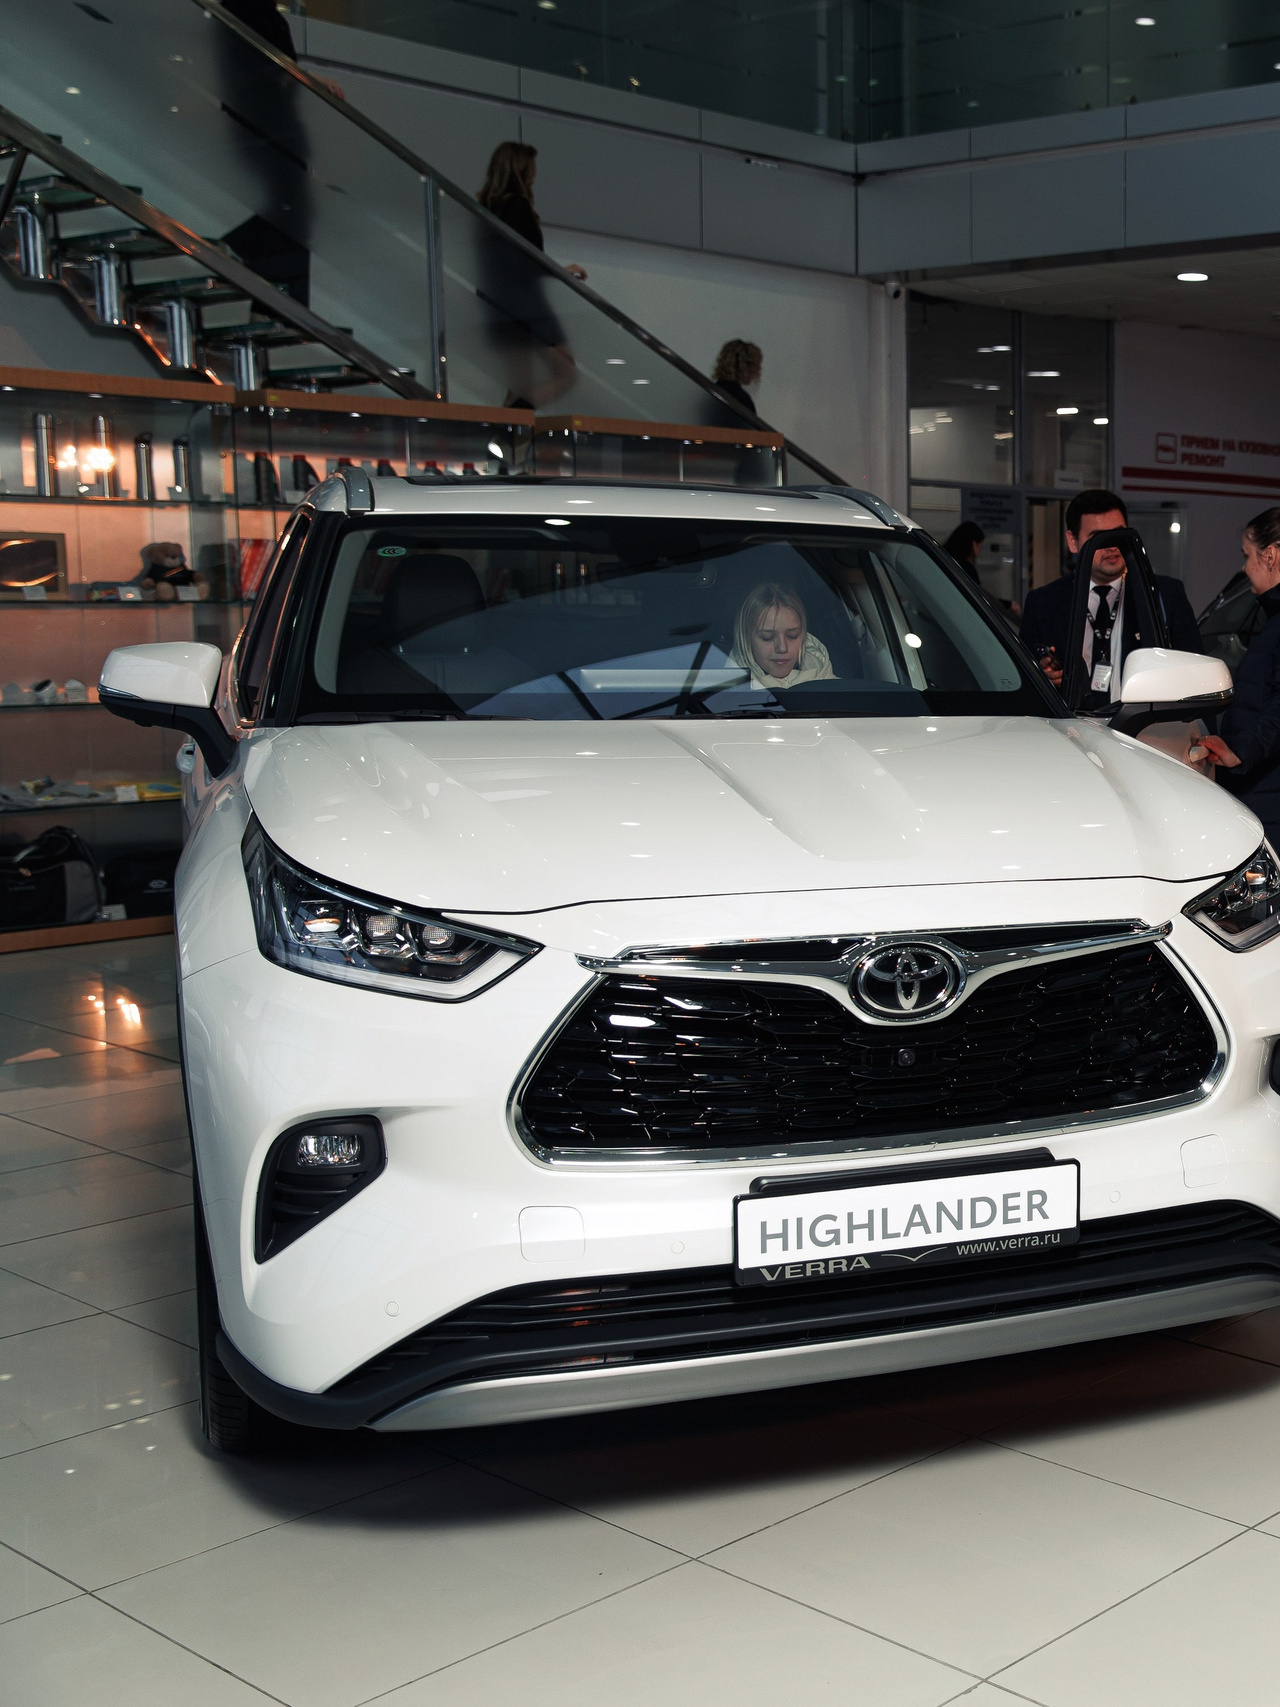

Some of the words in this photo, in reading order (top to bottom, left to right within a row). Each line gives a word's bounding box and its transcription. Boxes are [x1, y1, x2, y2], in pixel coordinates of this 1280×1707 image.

[1181, 435, 1220, 450] ПРИЕМ
[1222, 439, 1236, 451] НА
[1181, 453, 1226, 467] РЕМОНТ
[760, 1189, 1050, 1254] HIGHLANDER
[759, 1256, 871, 1281] VERRA
[956, 1232, 1061, 1256] www.verra.ru
